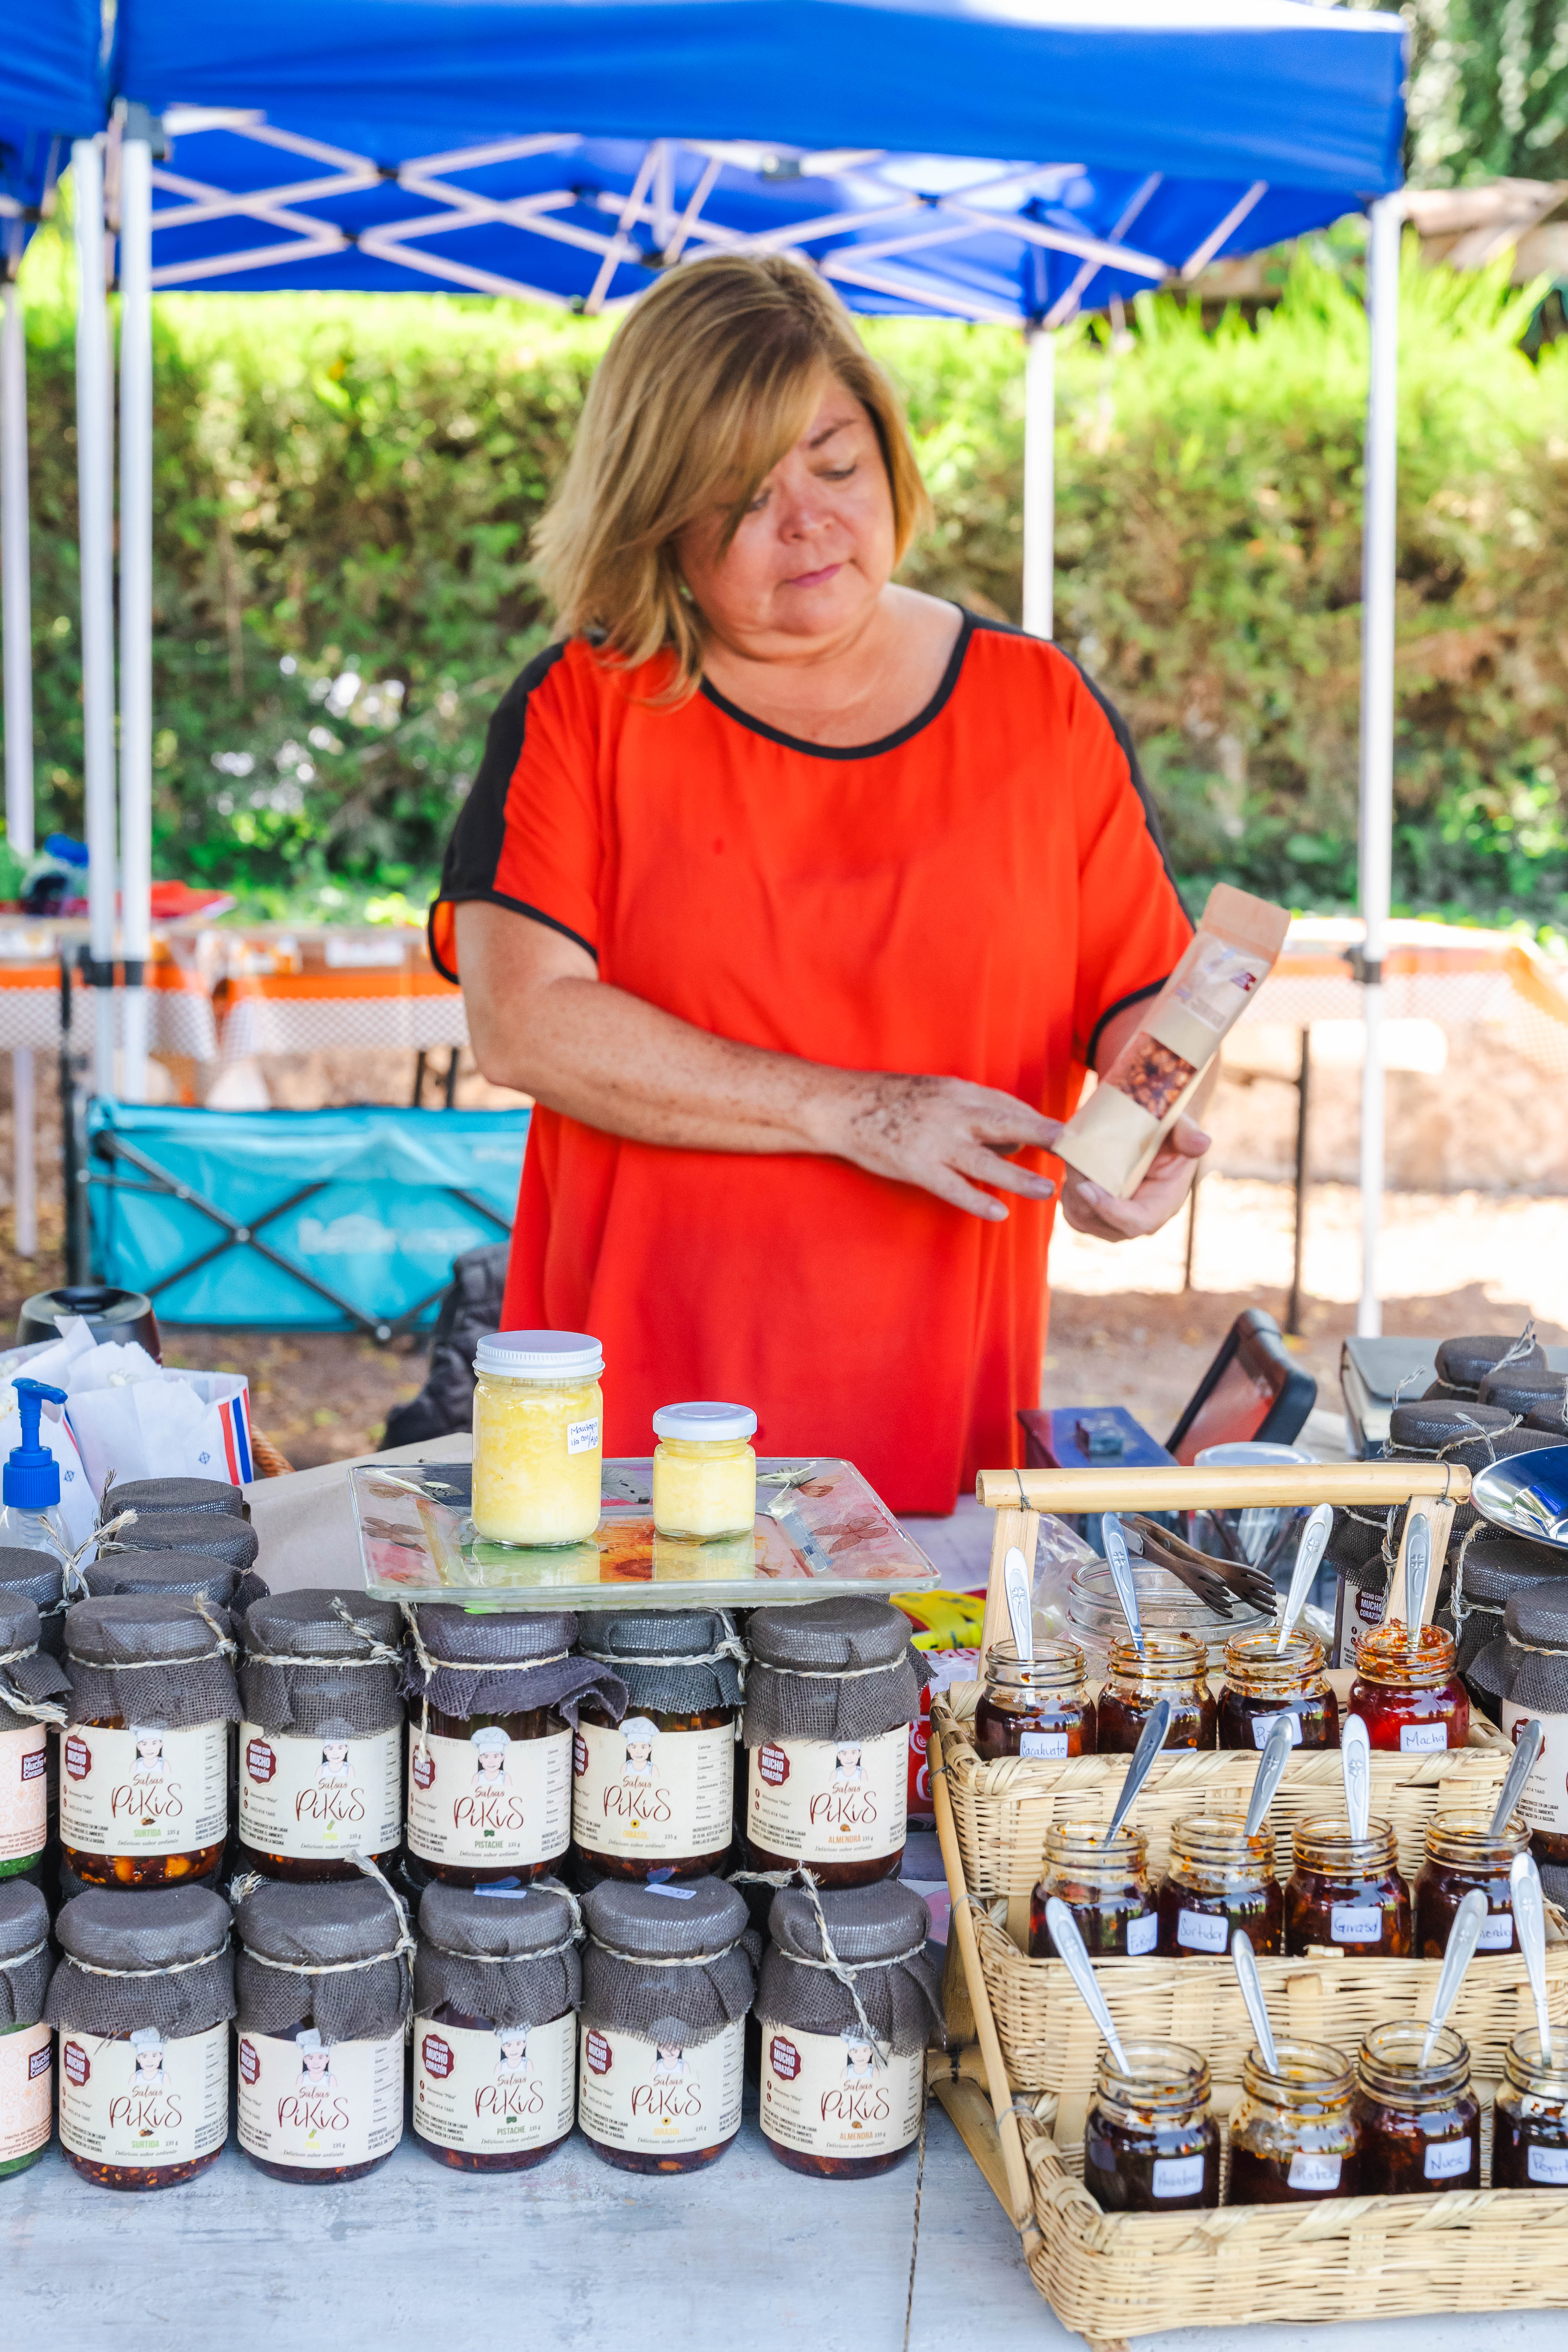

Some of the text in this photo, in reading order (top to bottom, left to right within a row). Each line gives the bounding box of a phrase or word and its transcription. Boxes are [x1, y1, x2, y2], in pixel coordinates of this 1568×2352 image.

[1362, 1591, 1374, 1600] HECHO
[1361, 1599, 1382, 1612] MUCHO
[1360, 1609, 1381, 1620] CORAZÓN
[1406, 1731, 1444, 1747] Macha
[762, 1746, 784, 1760] HECHO CON
[1022, 1741, 1065, 1757] Cacahuate
[23, 1759, 43, 1772] Mucho
[249, 1752, 271, 1768] MUCHO
[762, 1755, 784, 1772] MUCHO
[133, 1773, 163, 1786] Salsas
[761, 1767, 783, 1782] CORAZÓN
[318, 1778, 348, 1790] Salsas
[623, 1776, 652, 1788] Salsas
[832, 1782, 861, 1794] Salsas
[475, 1786, 504, 1798] Salsas
[133, 1829, 161, 1838] SURTIDA
[623, 1830, 648, 1839] GIRASOL
[828, 1835, 861, 1844] ALMENDRA
[1180, 1918, 1222, 1941] Surtida
[426, 2038, 448, 2053] HECHO CON
[588, 2042, 606, 2061] MUCHO
[774, 2039, 795, 2055] HECHO CON
[31, 2053, 50, 2070] Mucho
[426, 2047, 448, 2065] MUCHO
[774, 2048, 795, 2067] MUCHO
[67, 2054, 85, 2073] MUCHO
[773, 2060, 794, 2077] CORAZÓN
[497, 2074, 526, 2087] Salsas
[654, 2074, 683, 2087] Salsas
[843, 2079, 873, 2092] Salsas
[132, 2085, 163, 2098] Salsas
[299, 2087, 329, 2099] Salsas
[497, 2126, 525, 2136] PISTACHE
[654, 2127, 680, 2136] GIRASOL
[839, 2131, 873, 2141] ALMENDRA
[132, 2140, 159, 2148] SURTIDA
[1533, 2153, 1568, 2178] Pepit
